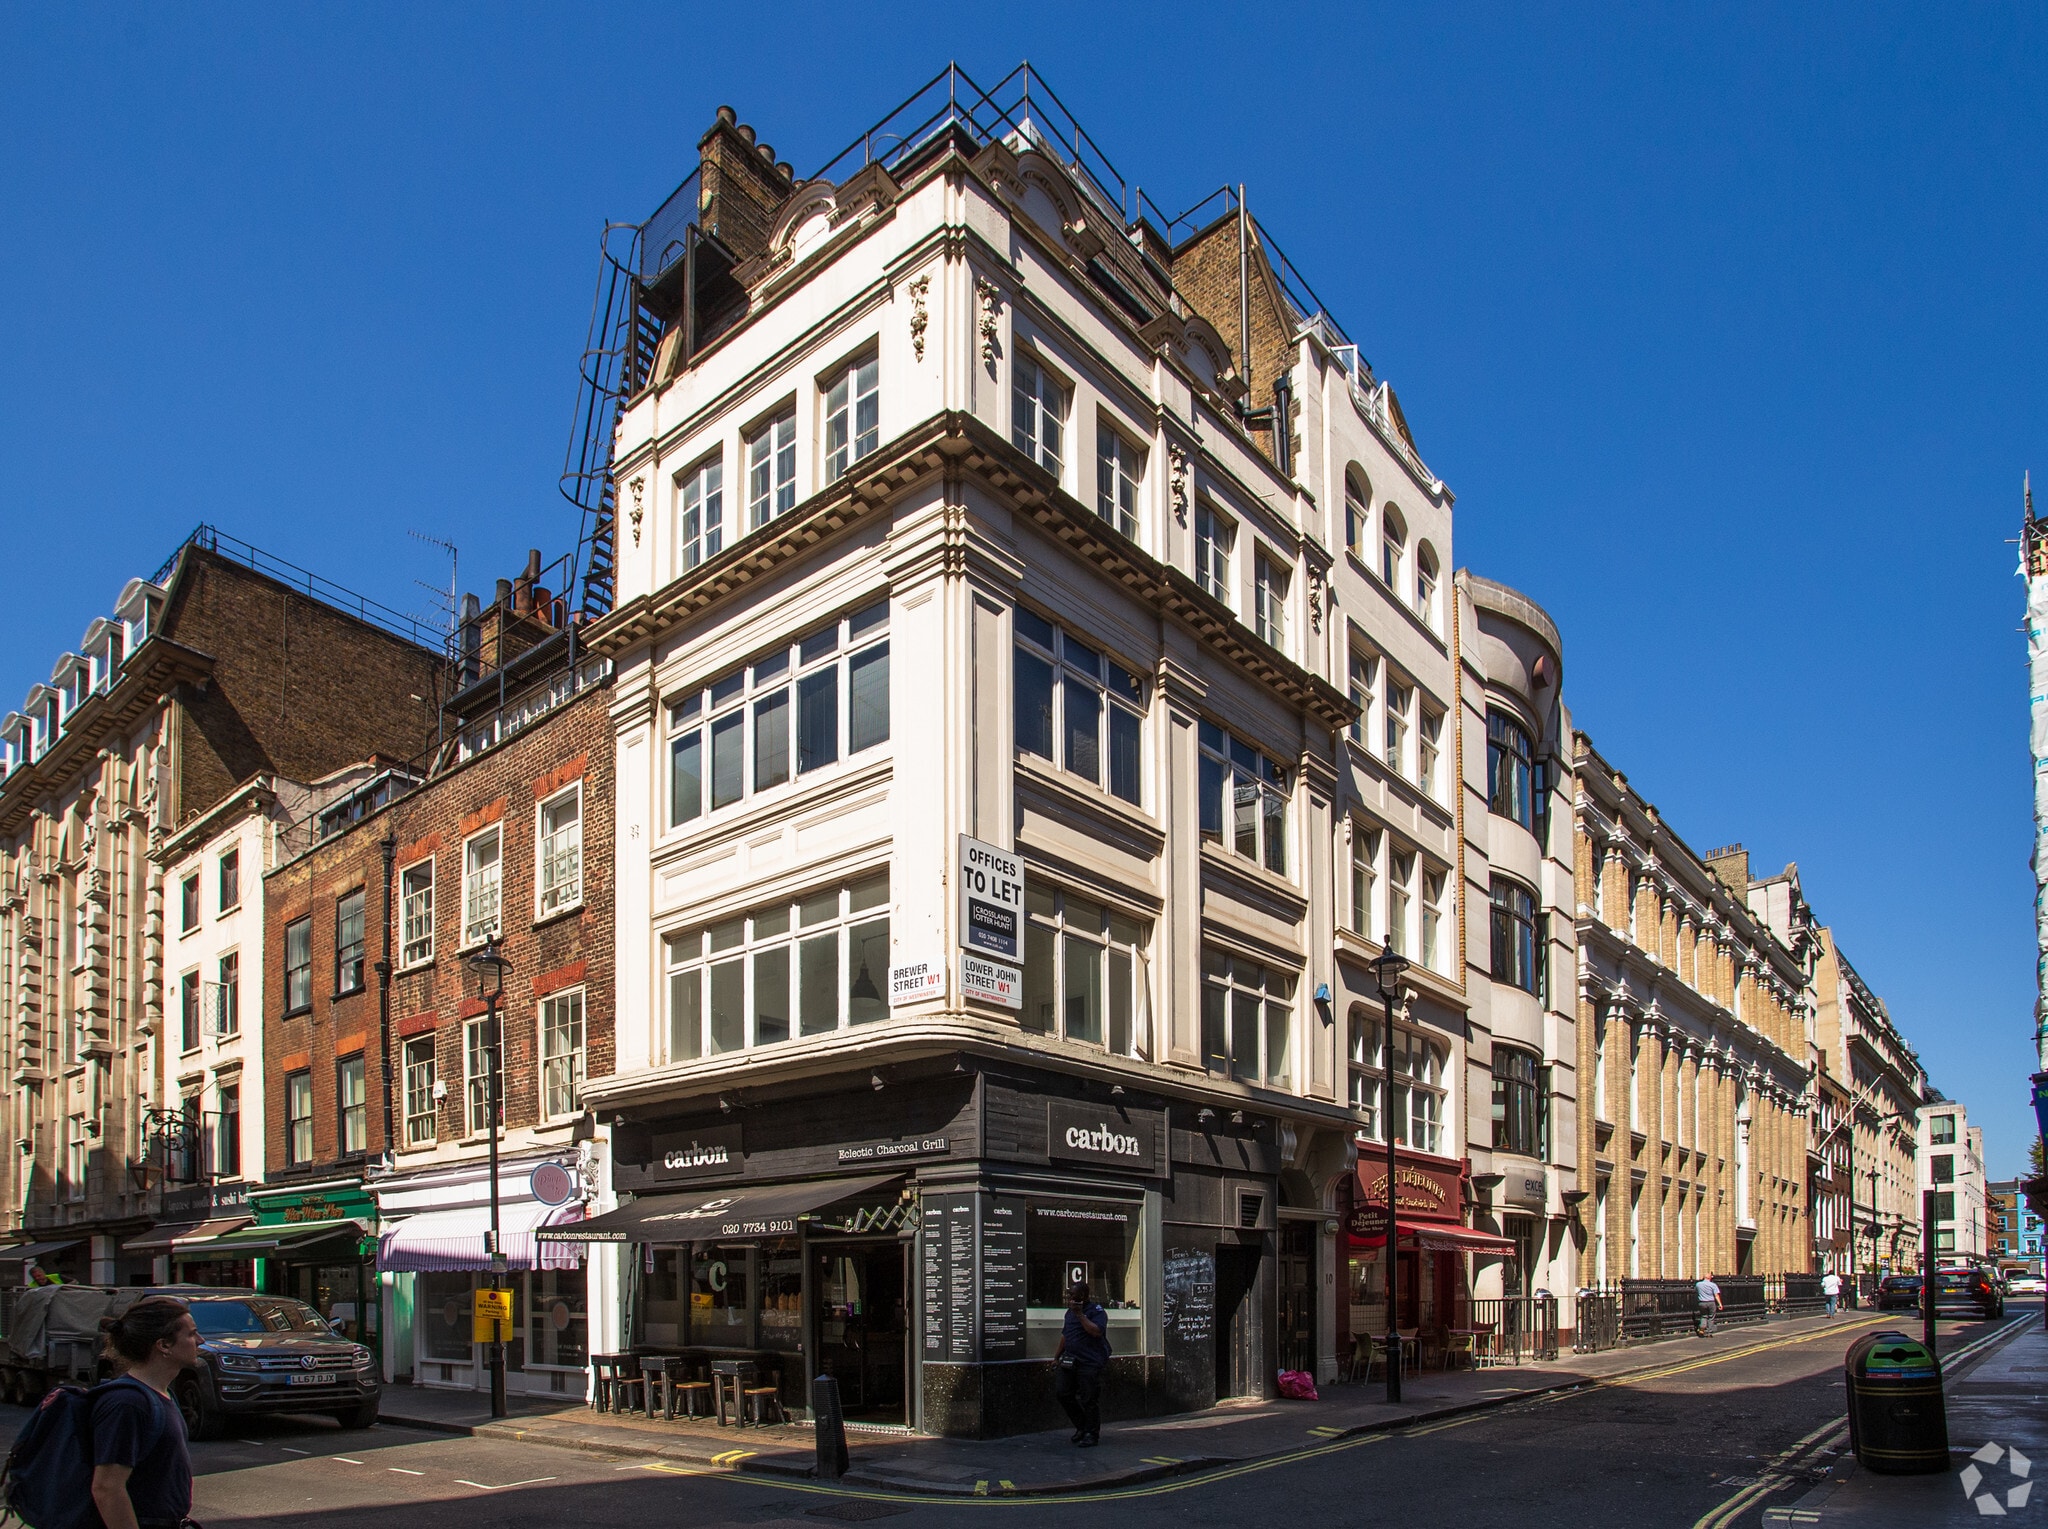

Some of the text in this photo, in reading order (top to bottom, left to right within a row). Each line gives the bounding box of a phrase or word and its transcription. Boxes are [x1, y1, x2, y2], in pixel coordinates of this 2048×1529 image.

[969, 848, 1016, 877] OFFICES
[963, 866, 1021, 905] TO LET
[975, 906, 1010, 922] CROSSLAND
[975, 914, 1010, 931] OTTER HUNT
[893, 963, 928, 979] BREWER
[965, 960, 1017, 983] LOWER JOHN
[893, 974, 940, 992] STREET W1
[965, 973, 1010, 994] STREET W1
[908, 990, 936, 1000] WESTMINSTER
[980, 992, 1007, 1003] WESTMINSTER
[1065, 1123, 1140, 1156] carbon
[664, 1140, 729, 1169] carbon
[838, 1139, 945, 1159] Eclectic Charcoal Grill
[1372, 1170, 1399, 1195] PETT
[211, 1194, 218, 1207] &
[221, 1192, 237, 1206] sushi
[1037, 1207, 1128, 1221] www.carbonrestaurant.com
[1358, 1211, 1378, 1220] Petit
[537, 1231, 627, 1240] www.carbonrestaurant.com
[722, 1220, 794, 1235] 020 7734 9101
[477, 1303, 508, 1311] WARNING
[291, 1374, 335, 1385] LL67 DJX
